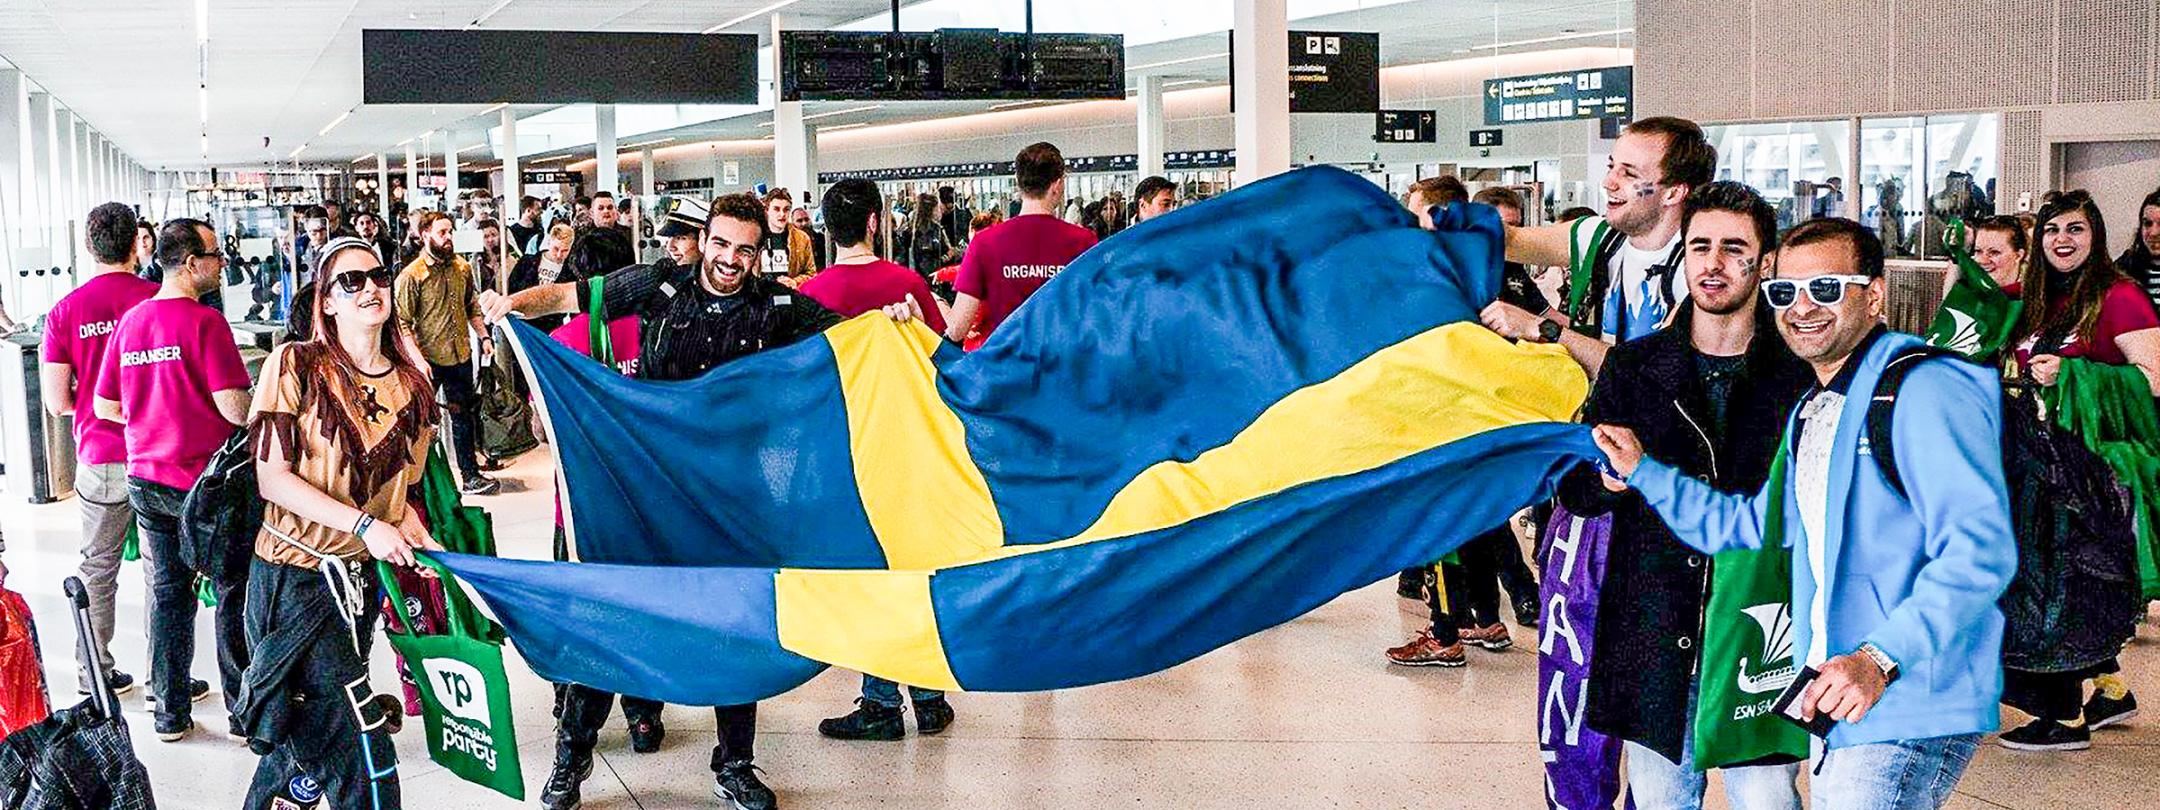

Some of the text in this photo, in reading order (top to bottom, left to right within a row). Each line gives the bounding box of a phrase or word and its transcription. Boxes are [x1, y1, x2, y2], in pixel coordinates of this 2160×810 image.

[79, 319, 118, 339] ORGA
[438, 670, 472, 708] rp
[1733, 704, 1756, 720] ESN
[442, 727, 498, 772] party
